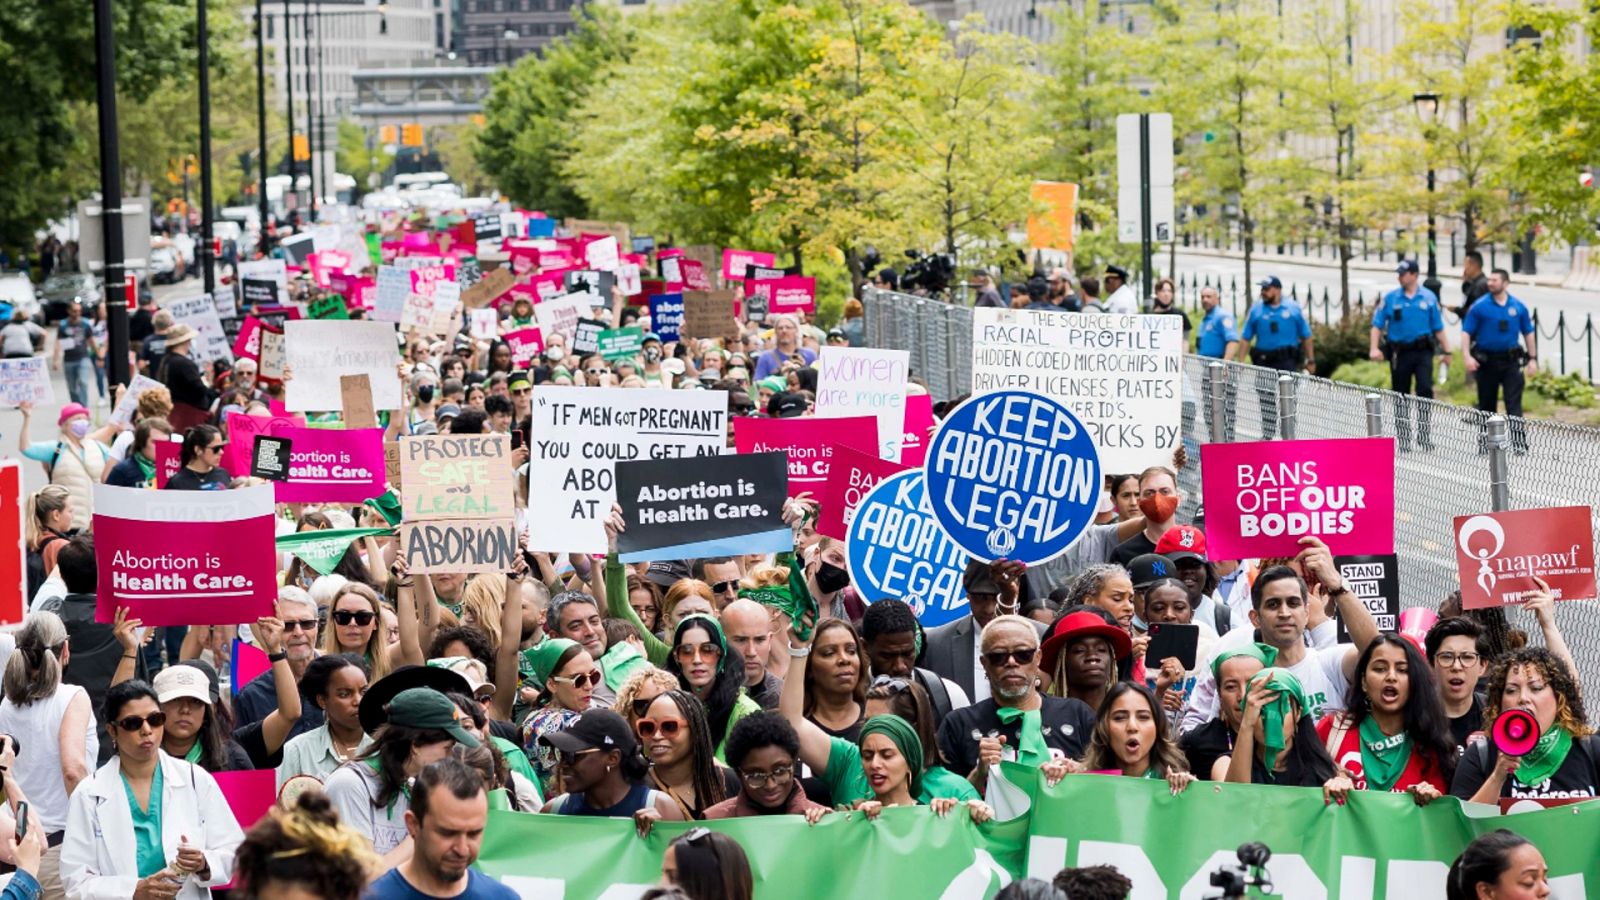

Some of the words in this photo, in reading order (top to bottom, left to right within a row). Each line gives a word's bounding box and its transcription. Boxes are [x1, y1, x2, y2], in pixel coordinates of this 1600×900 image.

[416, 266, 443, 281] YOU
[1029, 311, 1055, 327] THE
[1060, 314, 1114, 330] SOURCE
[1119, 315, 1137, 329] OF
[1142, 315, 1180, 331] NYPD
[984, 325, 1050, 346] RACIAL
[1069, 329, 1161, 350] PROFILE
[975, 349, 1021, 368] HIDDEN
[1026, 351, 1070, 371] CODED
[1074, 353, 1158, 373] MICROCHIPS
[1165, 355, 1179, 374] IN
[817, 388, 849, 407] are
[855, 389, 900, 408] more
[975, 373, 1030, 391] DRIVER
[1117, 379, 1174, 399] PLATES
[579, 406, 612, 428] MEN
[614, 411, 638, 428] GOT
[638, 407, 724, 432] PREGNANT
[972, 395, 1078, 449] KEEP
[1155, 425, 1179, 449] BY
[289, 450, 340, 463] bortion
[341, 450, 351, 463] is
[409, 438, 503, 461] PROTECT
[537, 440, 570, 460] YOU
[582, 441, 639, 461] COULD
[649, 444, 687, 460] GET
[695, 444, 721, 457] AN
[821, 443, 833, 458] is
[289, 465, 328, 479] ealth
[331, 466, 373, 479] Care.
[418, 460, 491, 486] SAFE
[935, 429, 1094, 505] ABORTION
[1236, 460, 1318, 488] BANS
[562, 468, 613, 492] ABO
[637, 483, 733, 503] Abortion
[737, 479, 756, 497] is
[415, 494, 499, 514] LEGAL
[943, 477, 1072, 544] LEGAL
[1236, 487, 1297, 513] OFF
[1299, 485, 1366, 510] OUR
[639, 504, 709, 524] Health
[714, 501, 769, 520] Care.
[1240, 510, 1355, 538] BODIES
[406, 521, 517, 570] ABORION
[857, 501, 968, 571] ABORTI
[111, 550, 200, 571] Abortion
[205, 552, 221, 569] is
[1342, 565, 1383, 579] STAND
[1496, 544, 1580, 577] napawf
[113, 572, 187, 593] Health
[192, 572, 254, 591] Care.
[1363, 600, 1385, 612] ACK
[1376, 616, 1394, 628] MEN
